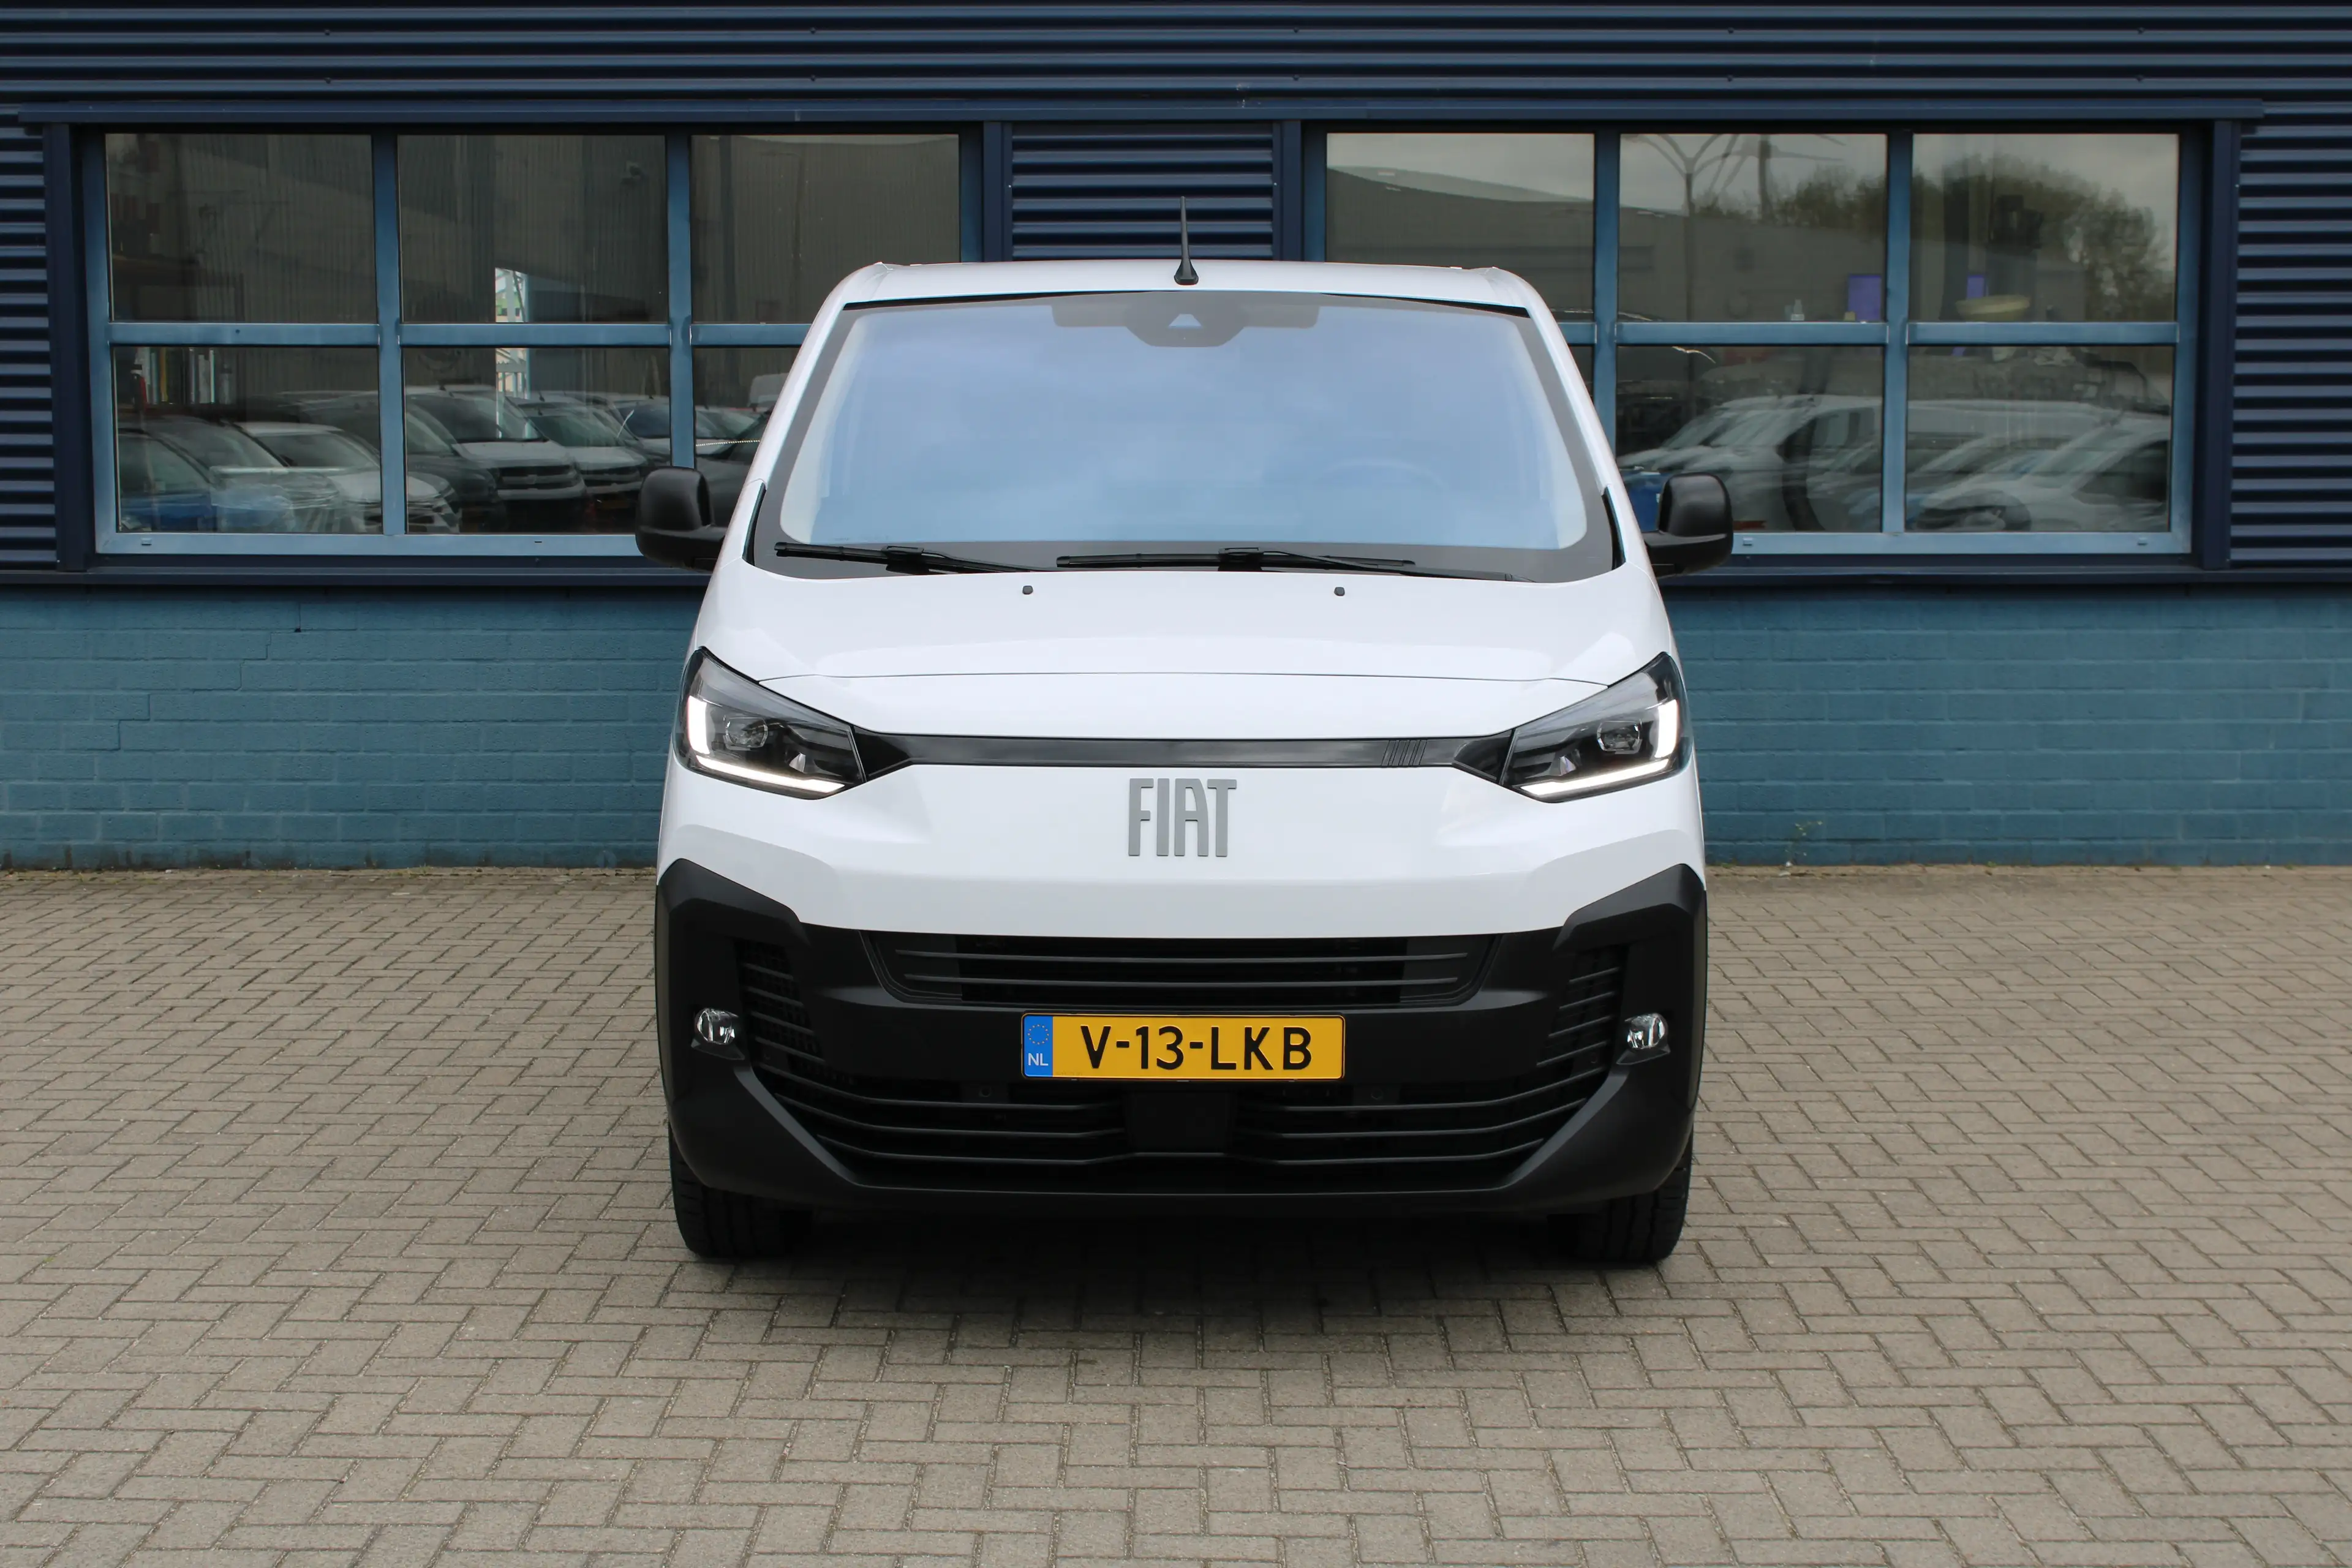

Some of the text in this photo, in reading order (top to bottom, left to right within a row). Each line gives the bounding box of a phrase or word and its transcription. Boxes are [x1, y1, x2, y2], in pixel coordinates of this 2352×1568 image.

[1128, 778, 1237, 857] FIAT
[1028, 1052, 1049, 1066] NL
[1080, 1025, 1312, 1071] V-13-LKB
